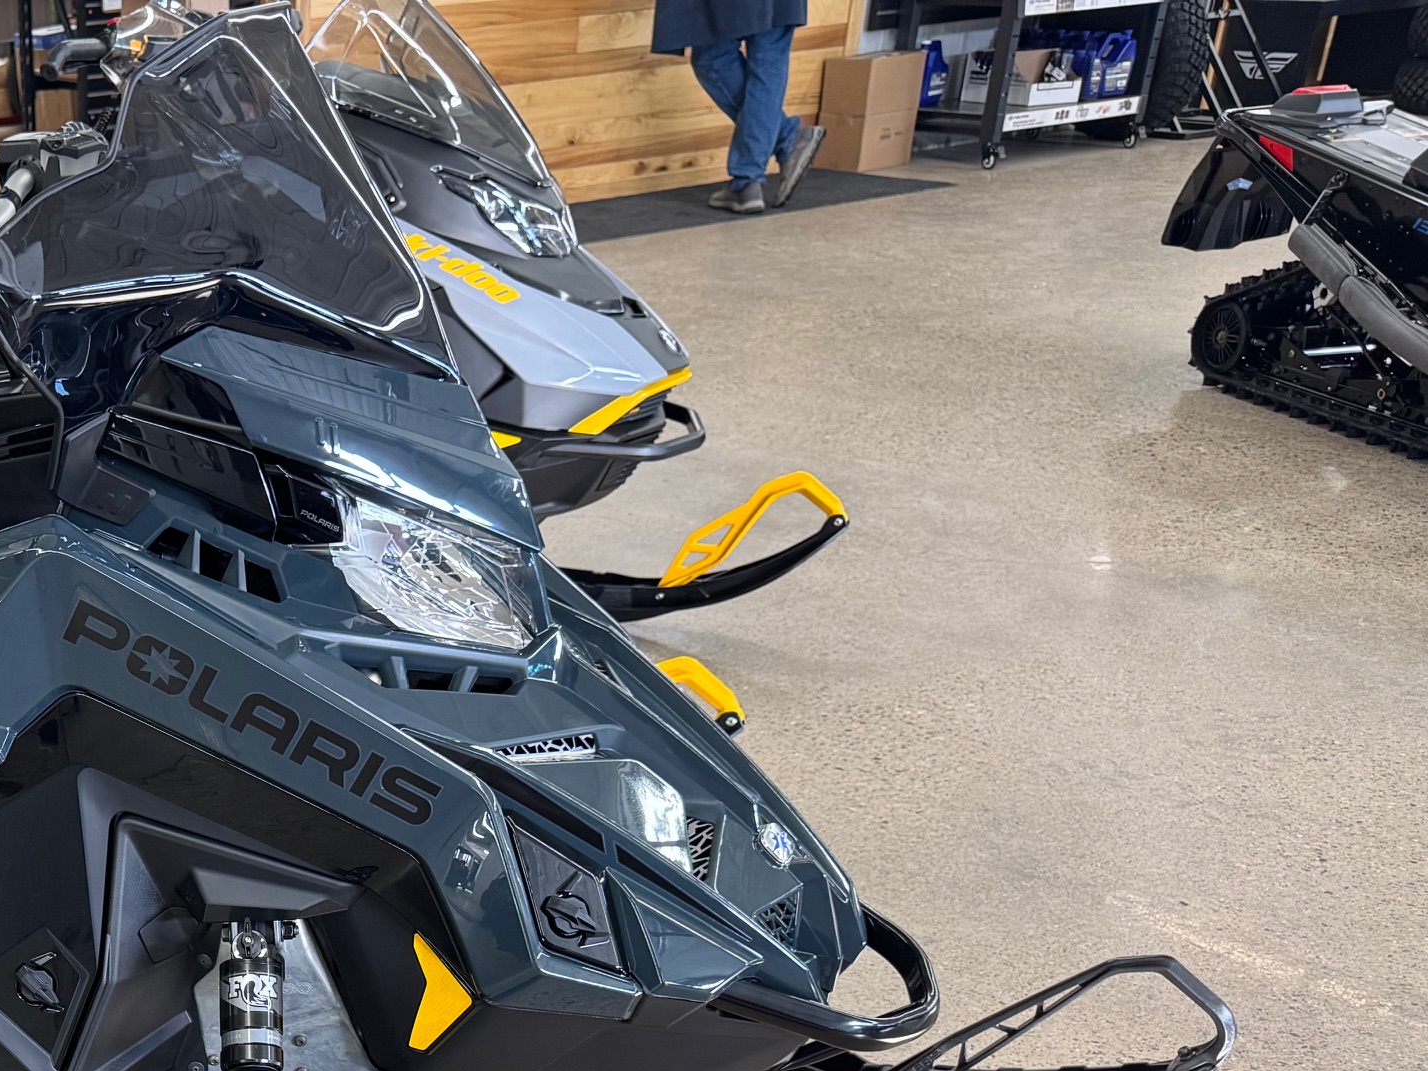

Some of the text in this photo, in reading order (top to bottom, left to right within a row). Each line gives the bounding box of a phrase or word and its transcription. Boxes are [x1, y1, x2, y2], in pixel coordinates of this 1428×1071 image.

[403, 232, 522, 304] ki-doo
[300, 508, 340, 533] POLARIS
[62, 599, 444, 826] POLARIS
[228, 974, 278, 1003] FOX
